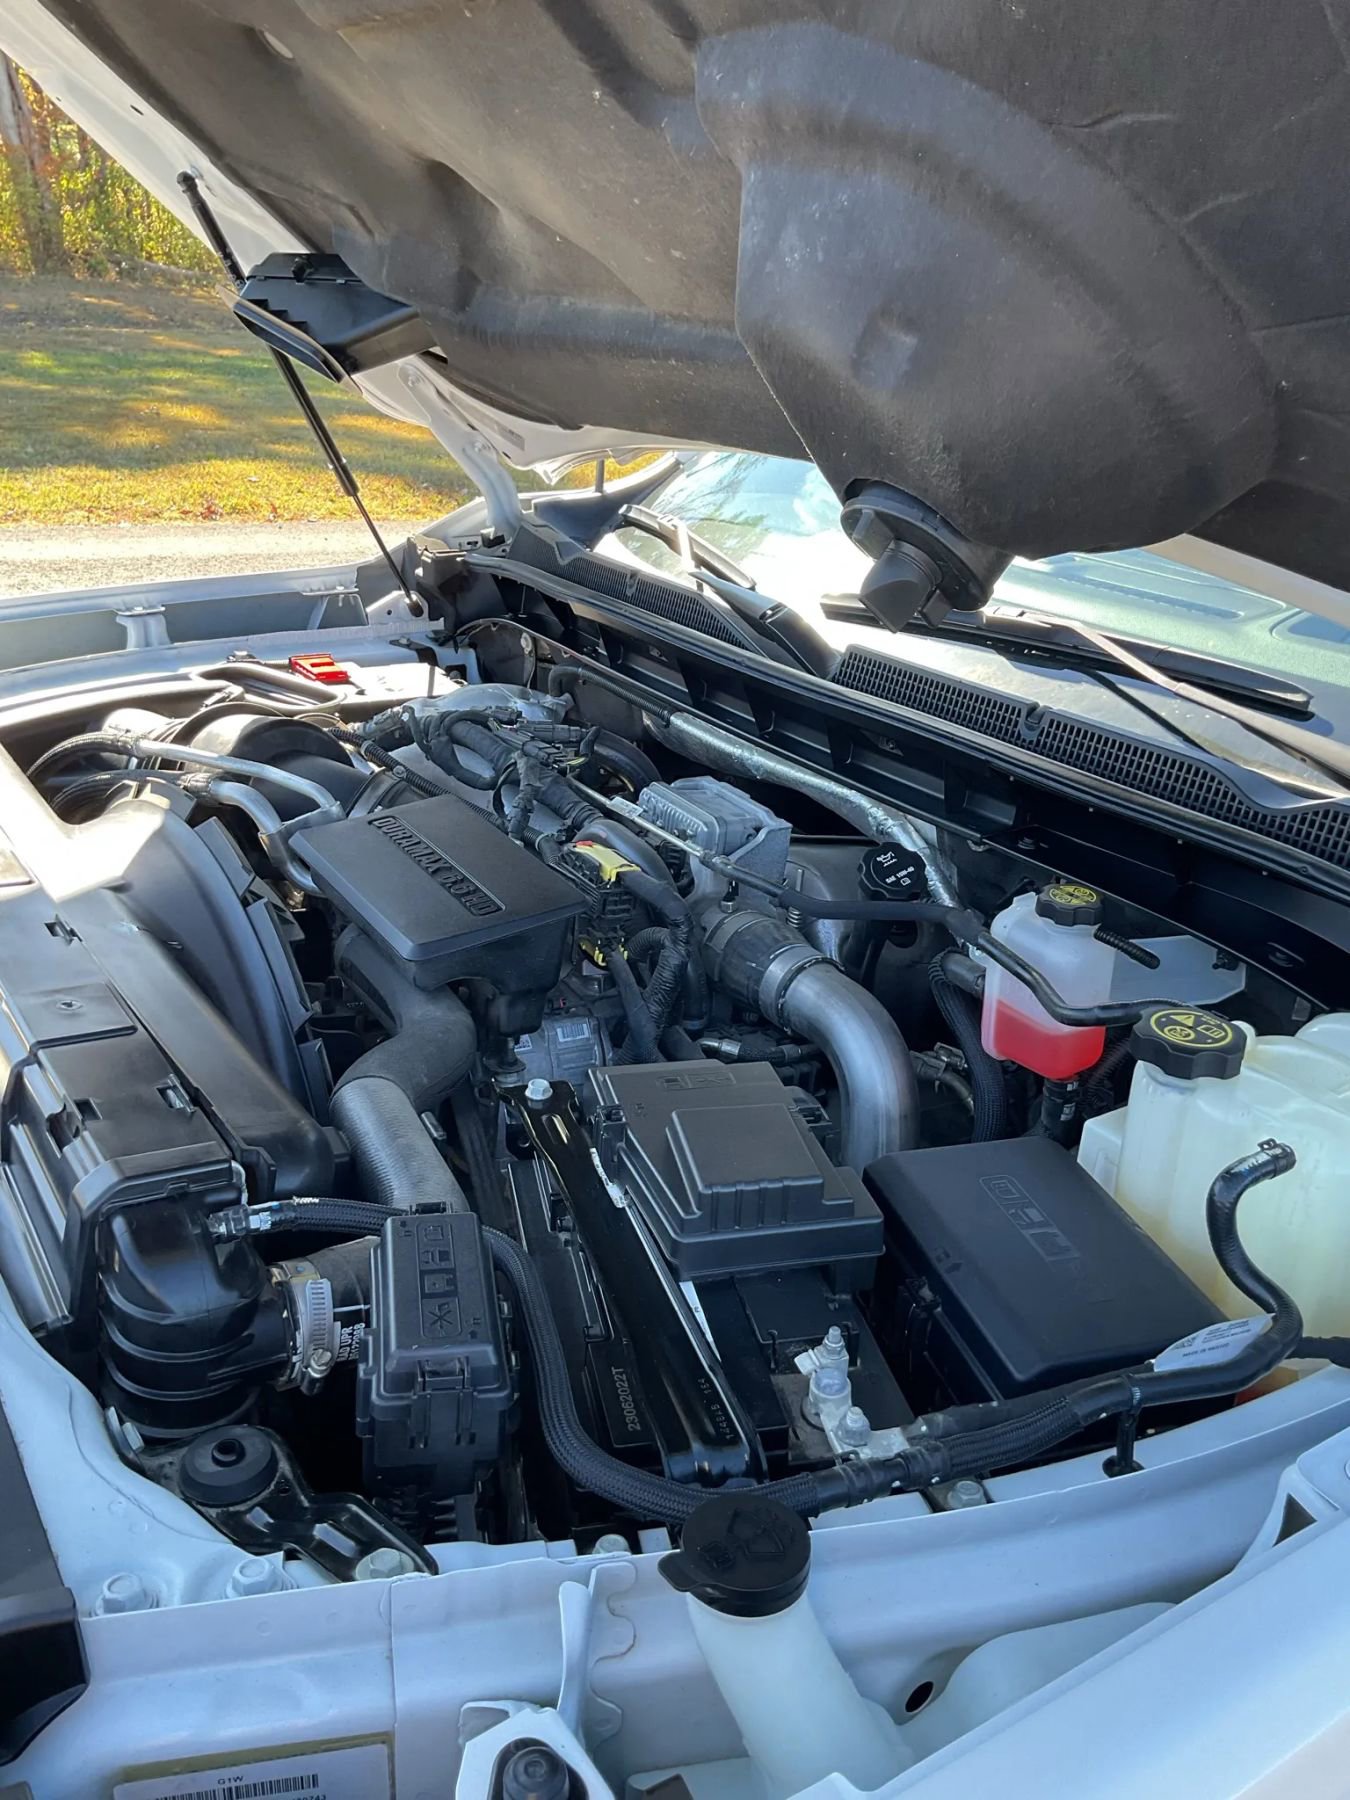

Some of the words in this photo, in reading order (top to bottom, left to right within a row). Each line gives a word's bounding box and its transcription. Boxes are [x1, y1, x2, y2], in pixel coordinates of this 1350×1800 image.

[373, 817, 452, 874] DURAMAX
[441, 873, 476, 896] 6.6
[461, 893, 499, 915] HD
[340, 1326, 353, 1346] UPR
[611, 1366, 641, 1432] 23062022T
[217, 1775, 244, 1785] G1W
